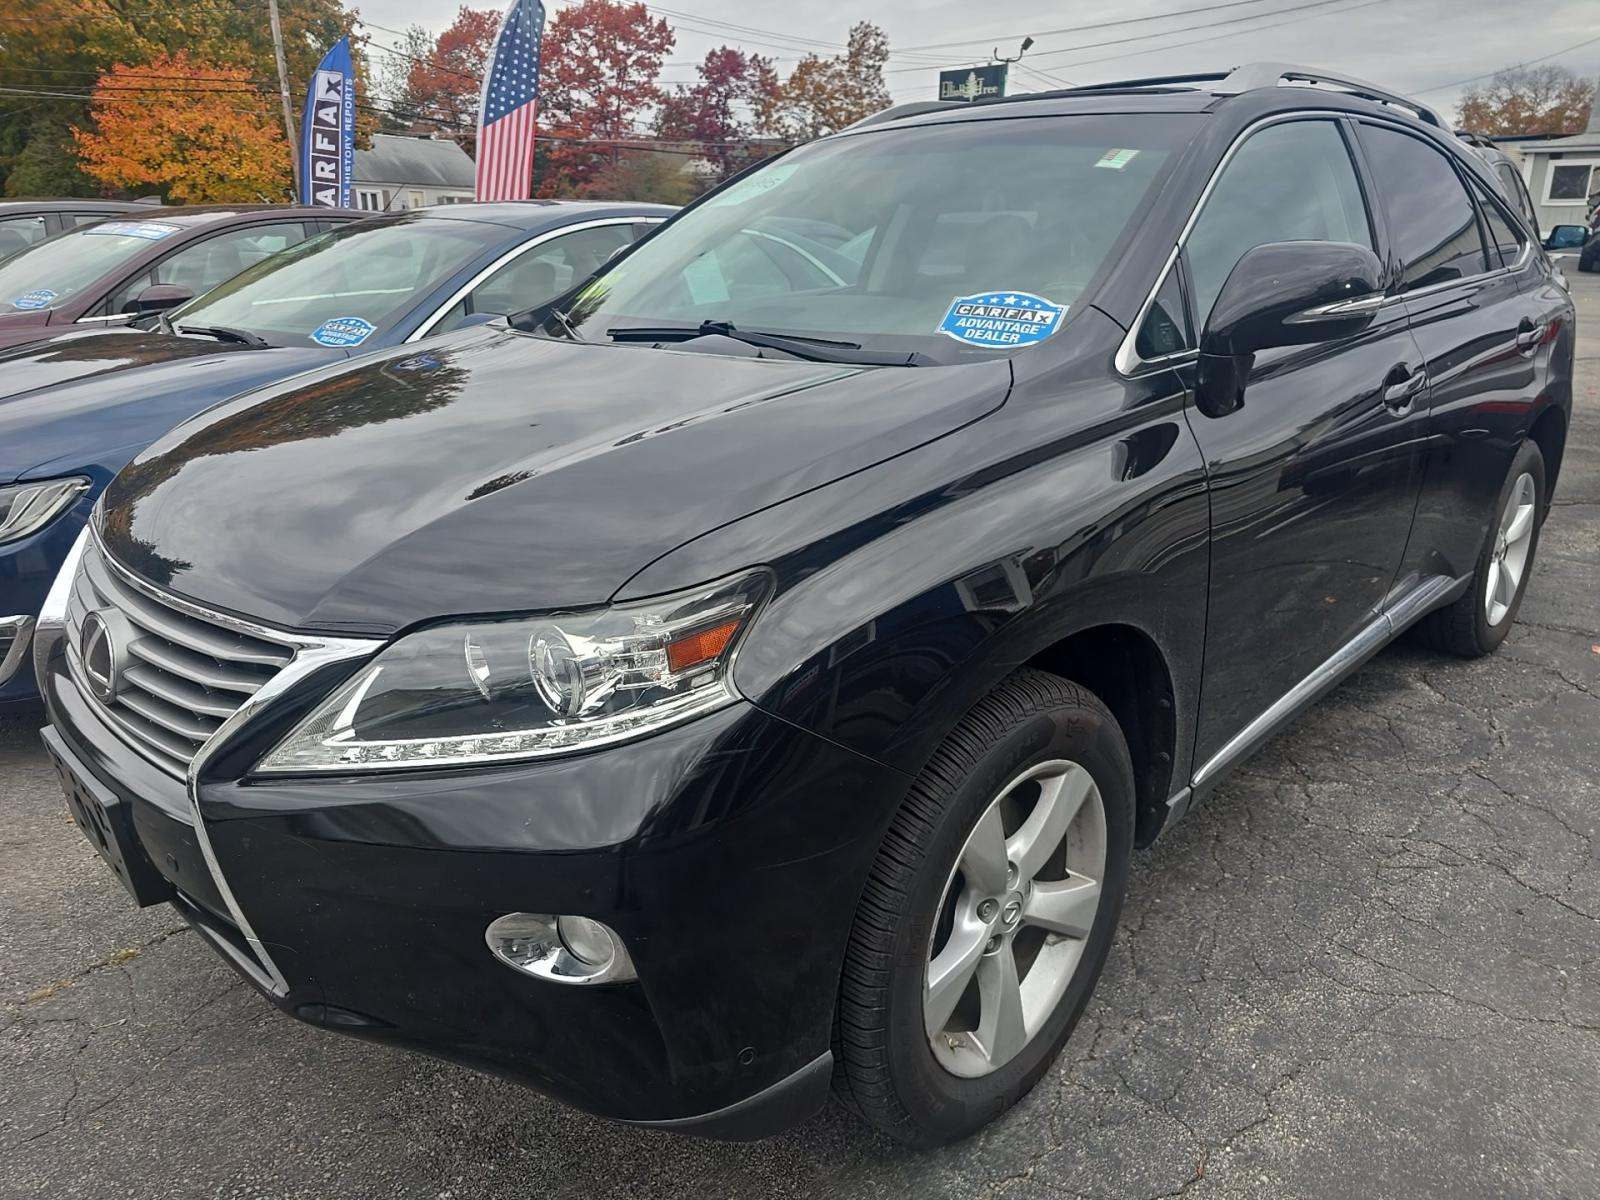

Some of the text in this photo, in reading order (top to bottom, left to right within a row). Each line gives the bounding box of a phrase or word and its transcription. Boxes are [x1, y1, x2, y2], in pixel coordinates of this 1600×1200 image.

[976, 77, 999, 95] Tree
[344, 78, 353, 131] REPORTS
[315, 77, 342, 208] ARFAX
[344, 135, 352, 184] HISTORY
[957, 304, 1052, 324] CARFAX
[956, 317, 1041, 335] ADVANTAGE
[965, 328, 1021, 343] DEALER
